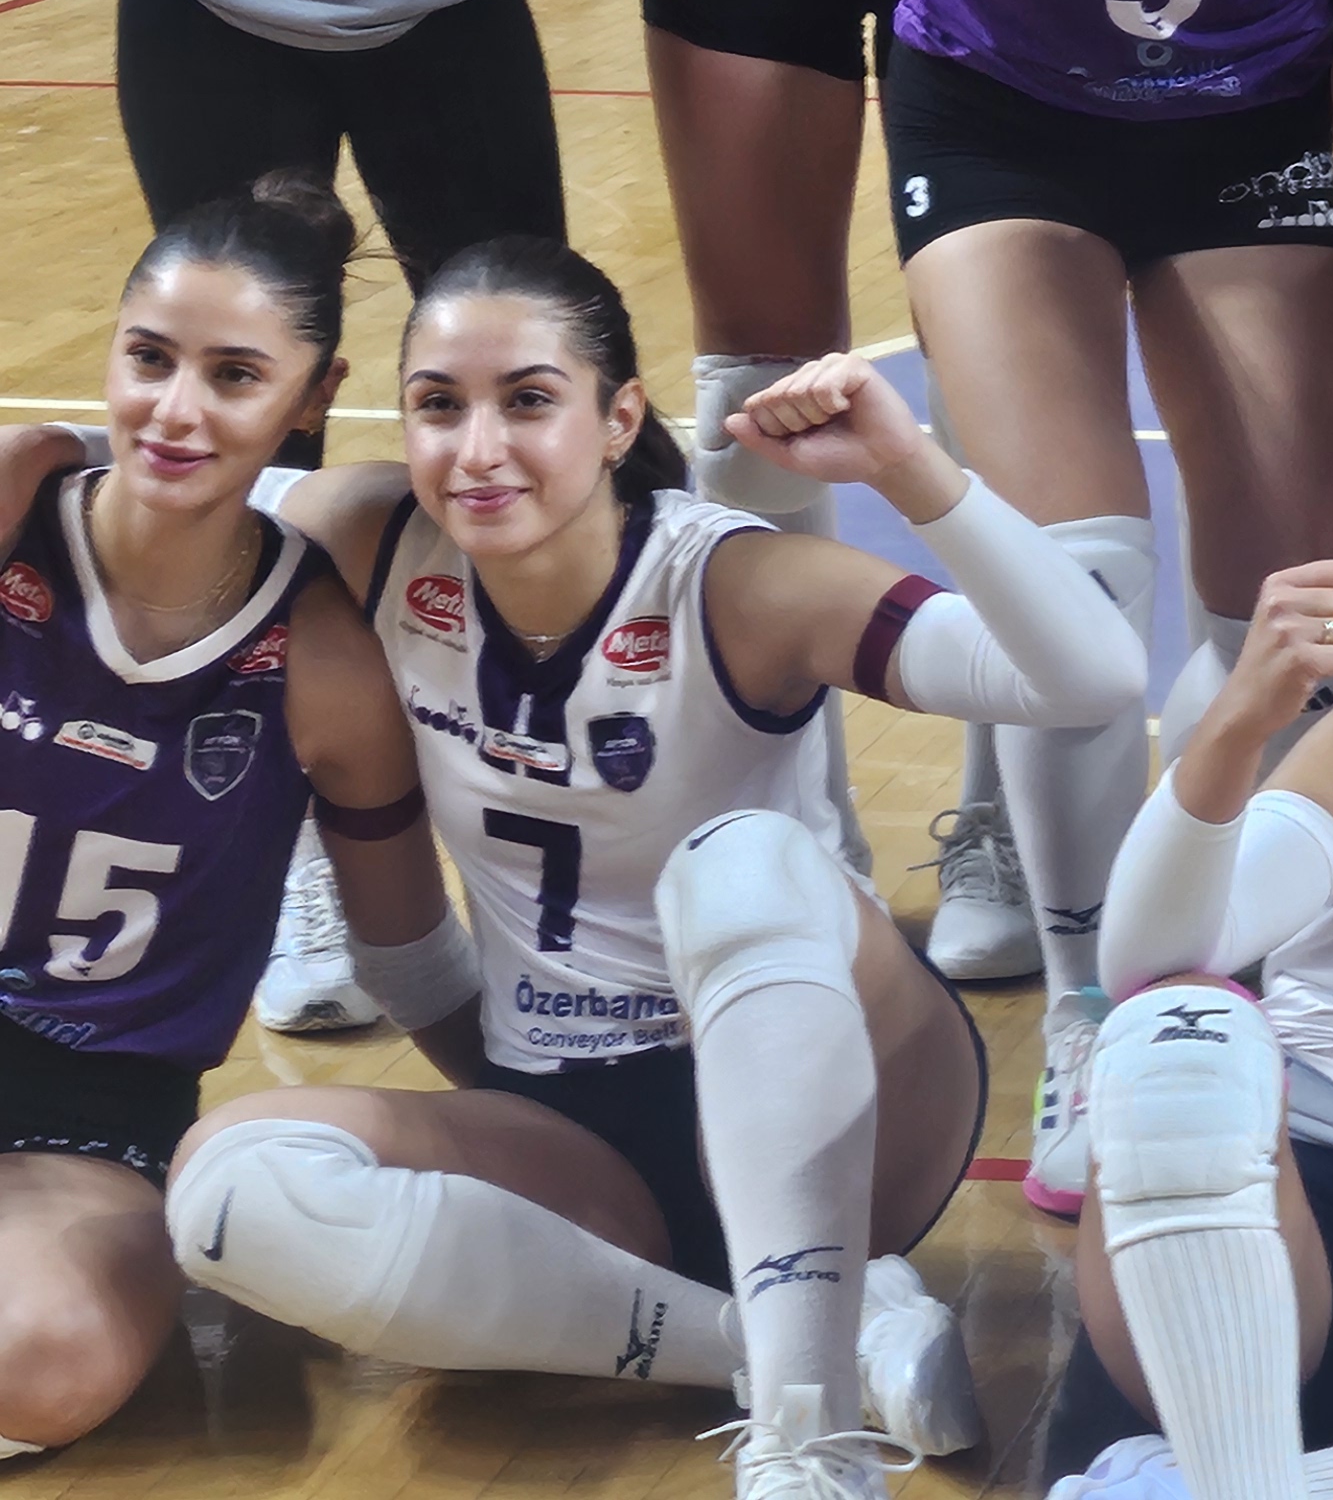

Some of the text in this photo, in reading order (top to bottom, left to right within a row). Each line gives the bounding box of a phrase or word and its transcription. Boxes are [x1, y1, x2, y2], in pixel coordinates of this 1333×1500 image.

[903, 174, 931, 218] 3
[0, 809, 184, 982] 15
[482, 807, 582, 953] 7
[527, 1026, 628, 1054] Conveyor
